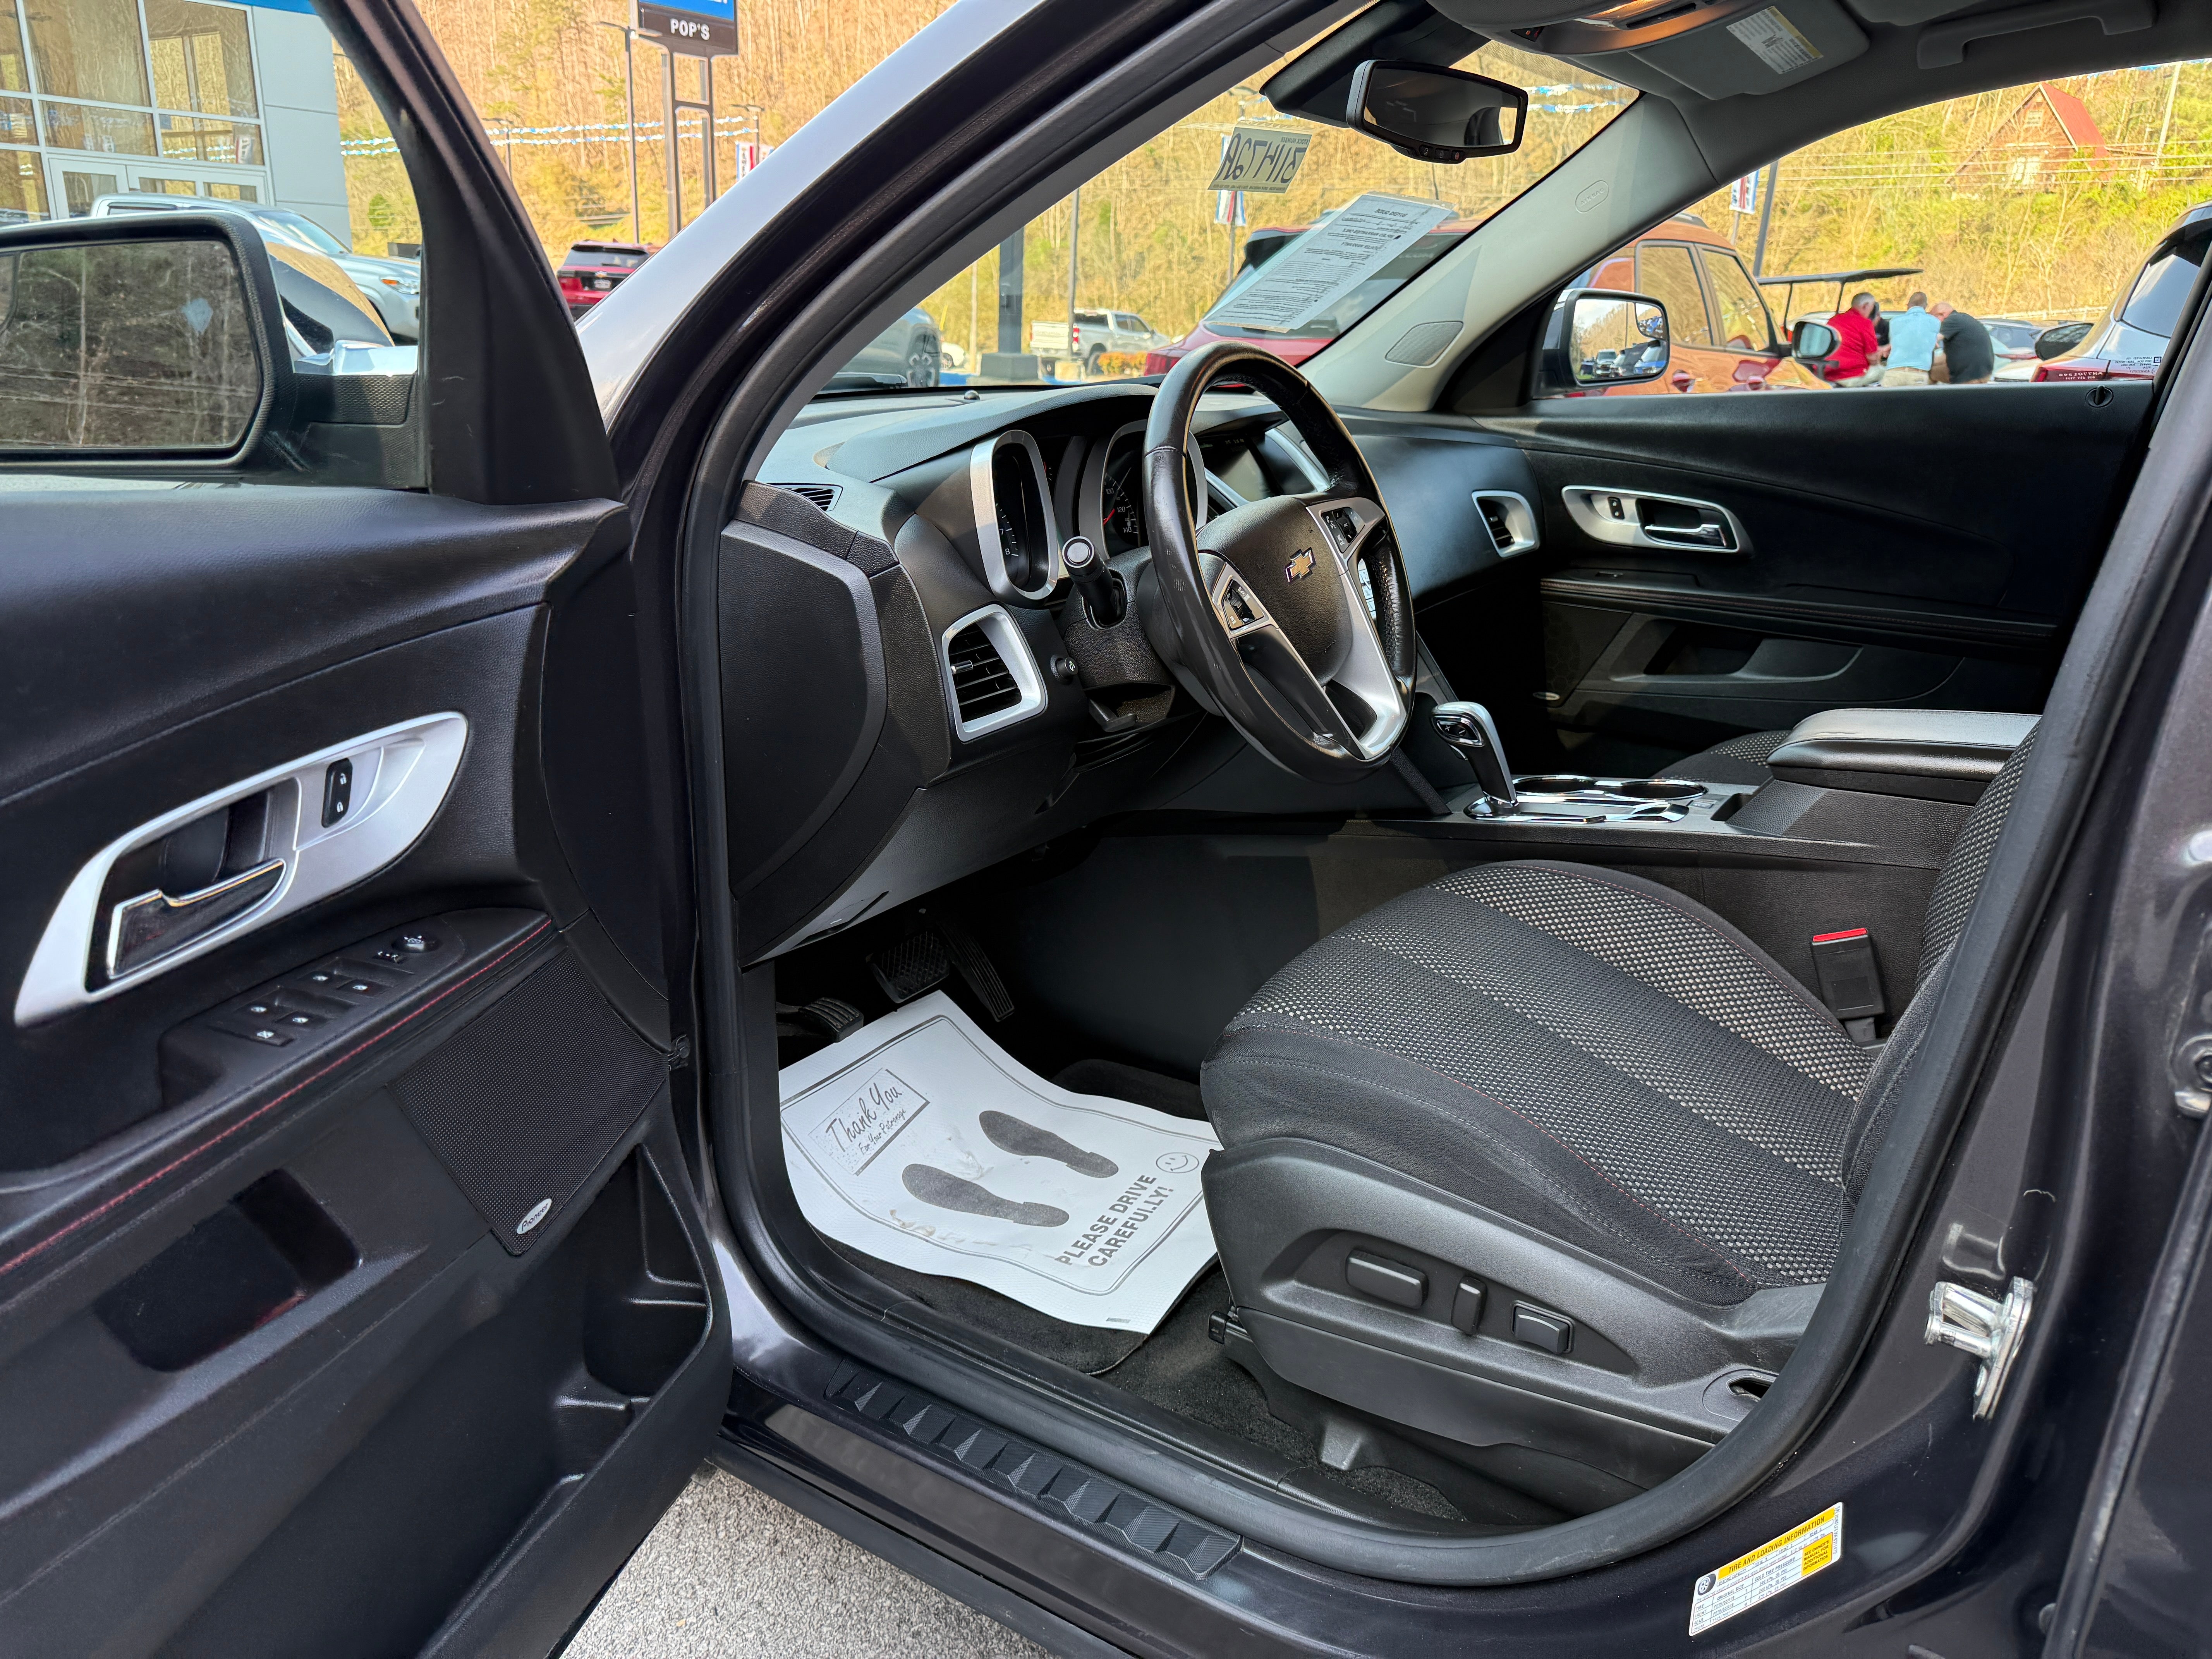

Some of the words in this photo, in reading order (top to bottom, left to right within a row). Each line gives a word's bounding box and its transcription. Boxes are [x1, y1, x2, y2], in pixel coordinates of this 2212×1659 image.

[670, 18, 710, 40] POP'S
[826, 1097, 877, 1152] Thank
[869, 1082, 902, 1111] You
[521, 1203, 549, 1232] Pioneer
[1054, 1214, 1118, 1266] PLEASE
[1108, 1175, 1157, 1214] DRIVE
[1087, 1186, 1174, 1266] CAREFULLY!
[1729, 1562, 1741, 1573] TIRE
[1743, 1554, 1755, 1565] AND
[1757, 1540, 1782, 1558] LOADING
[1784, 1516, 1825, 1544] INFORMATION
